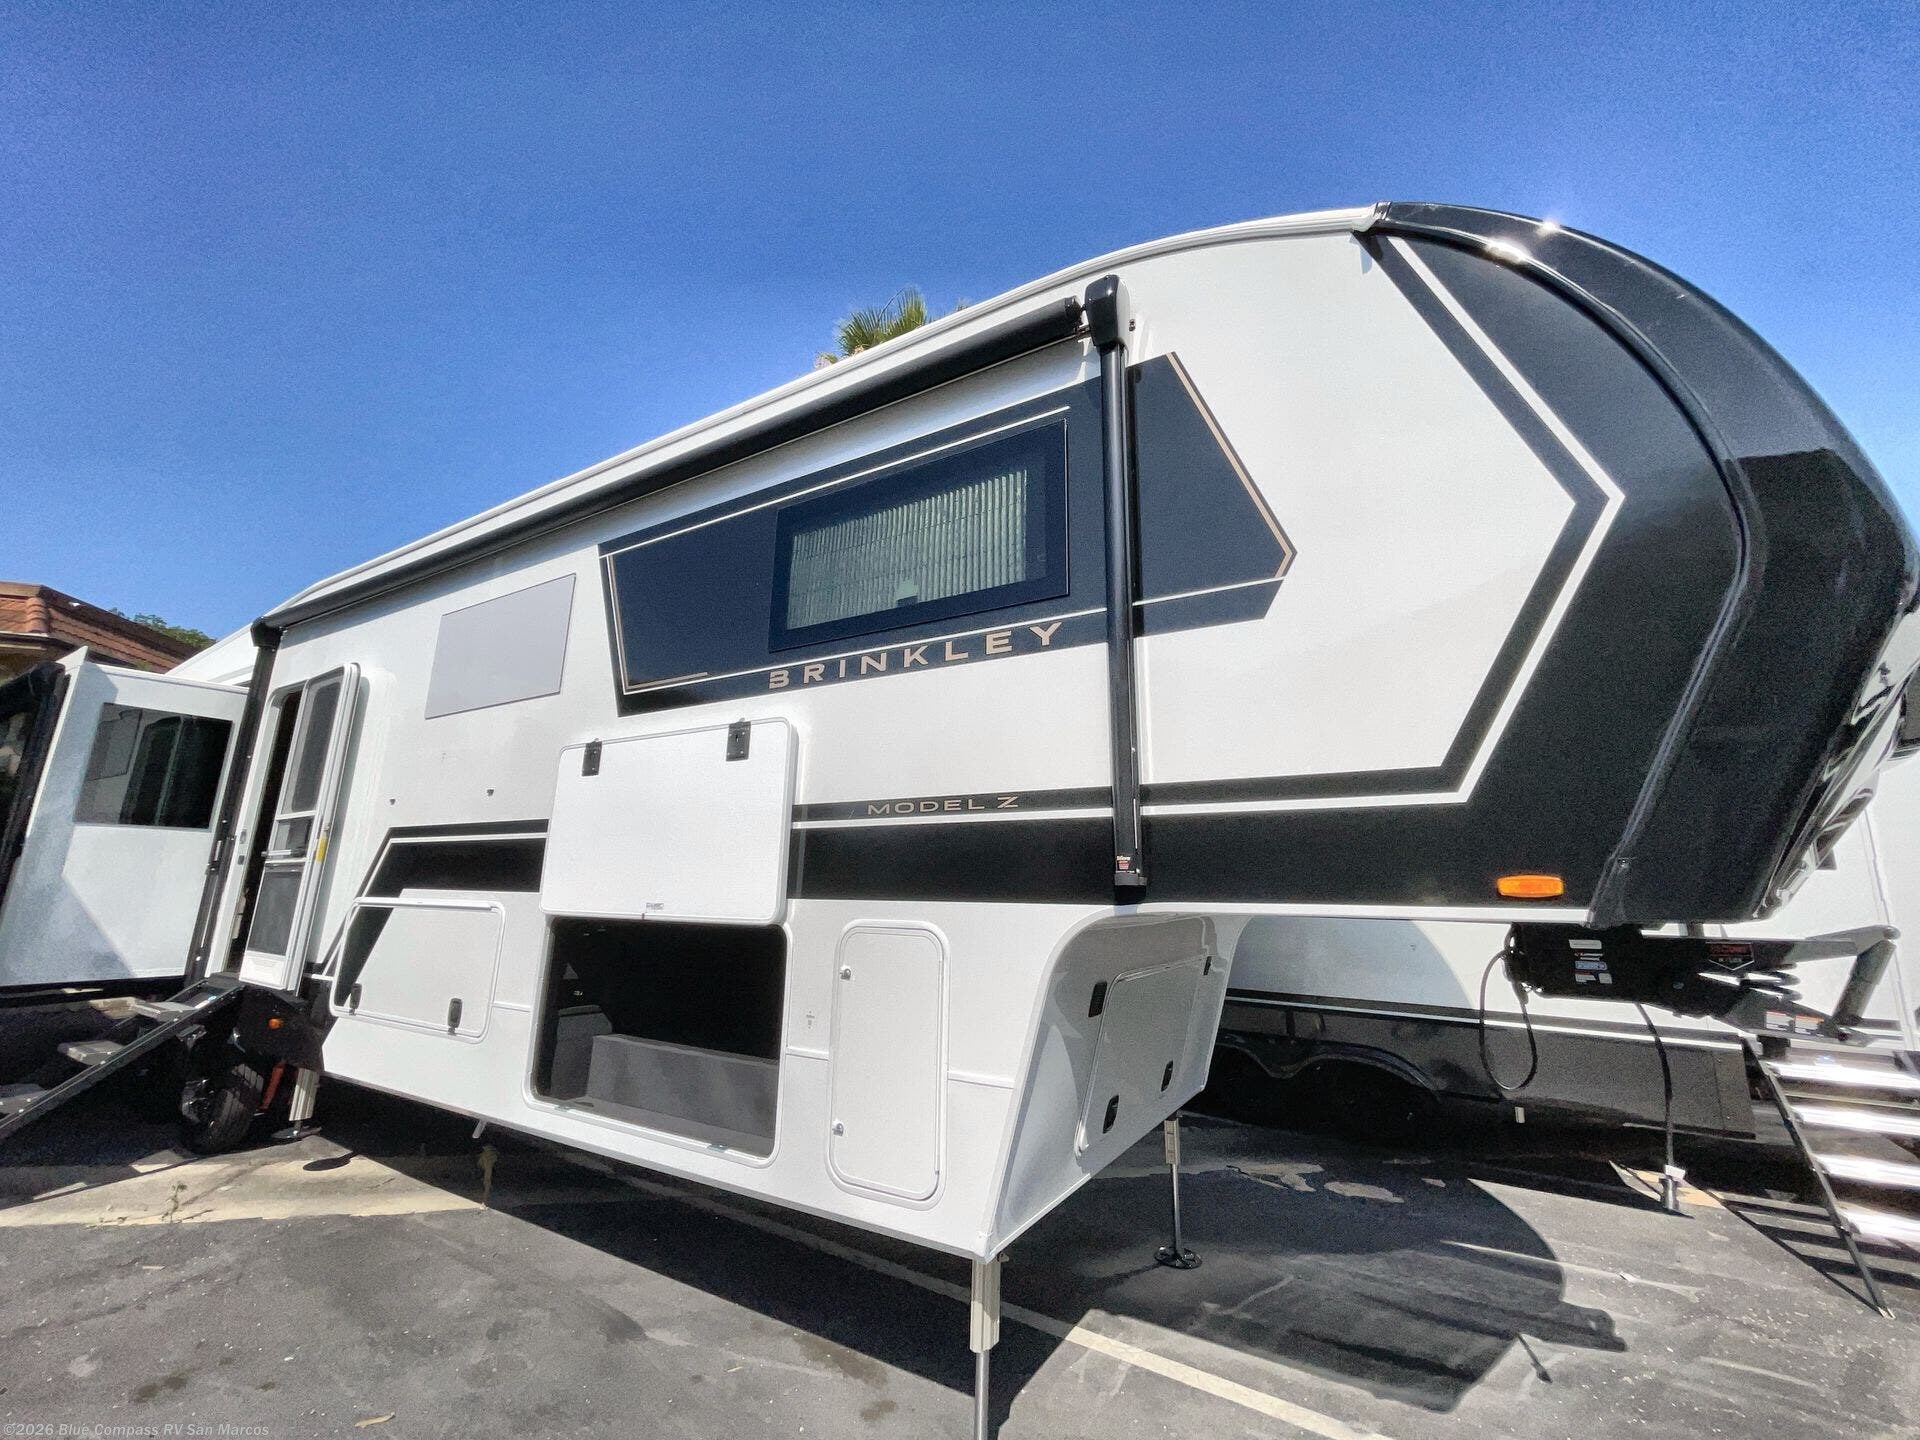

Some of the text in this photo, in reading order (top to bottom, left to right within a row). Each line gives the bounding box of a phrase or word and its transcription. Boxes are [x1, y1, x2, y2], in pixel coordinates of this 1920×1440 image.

[768, 621, 1063, 690] BRINKLEY
[867, 795, 1019, 816] MODEL Z
